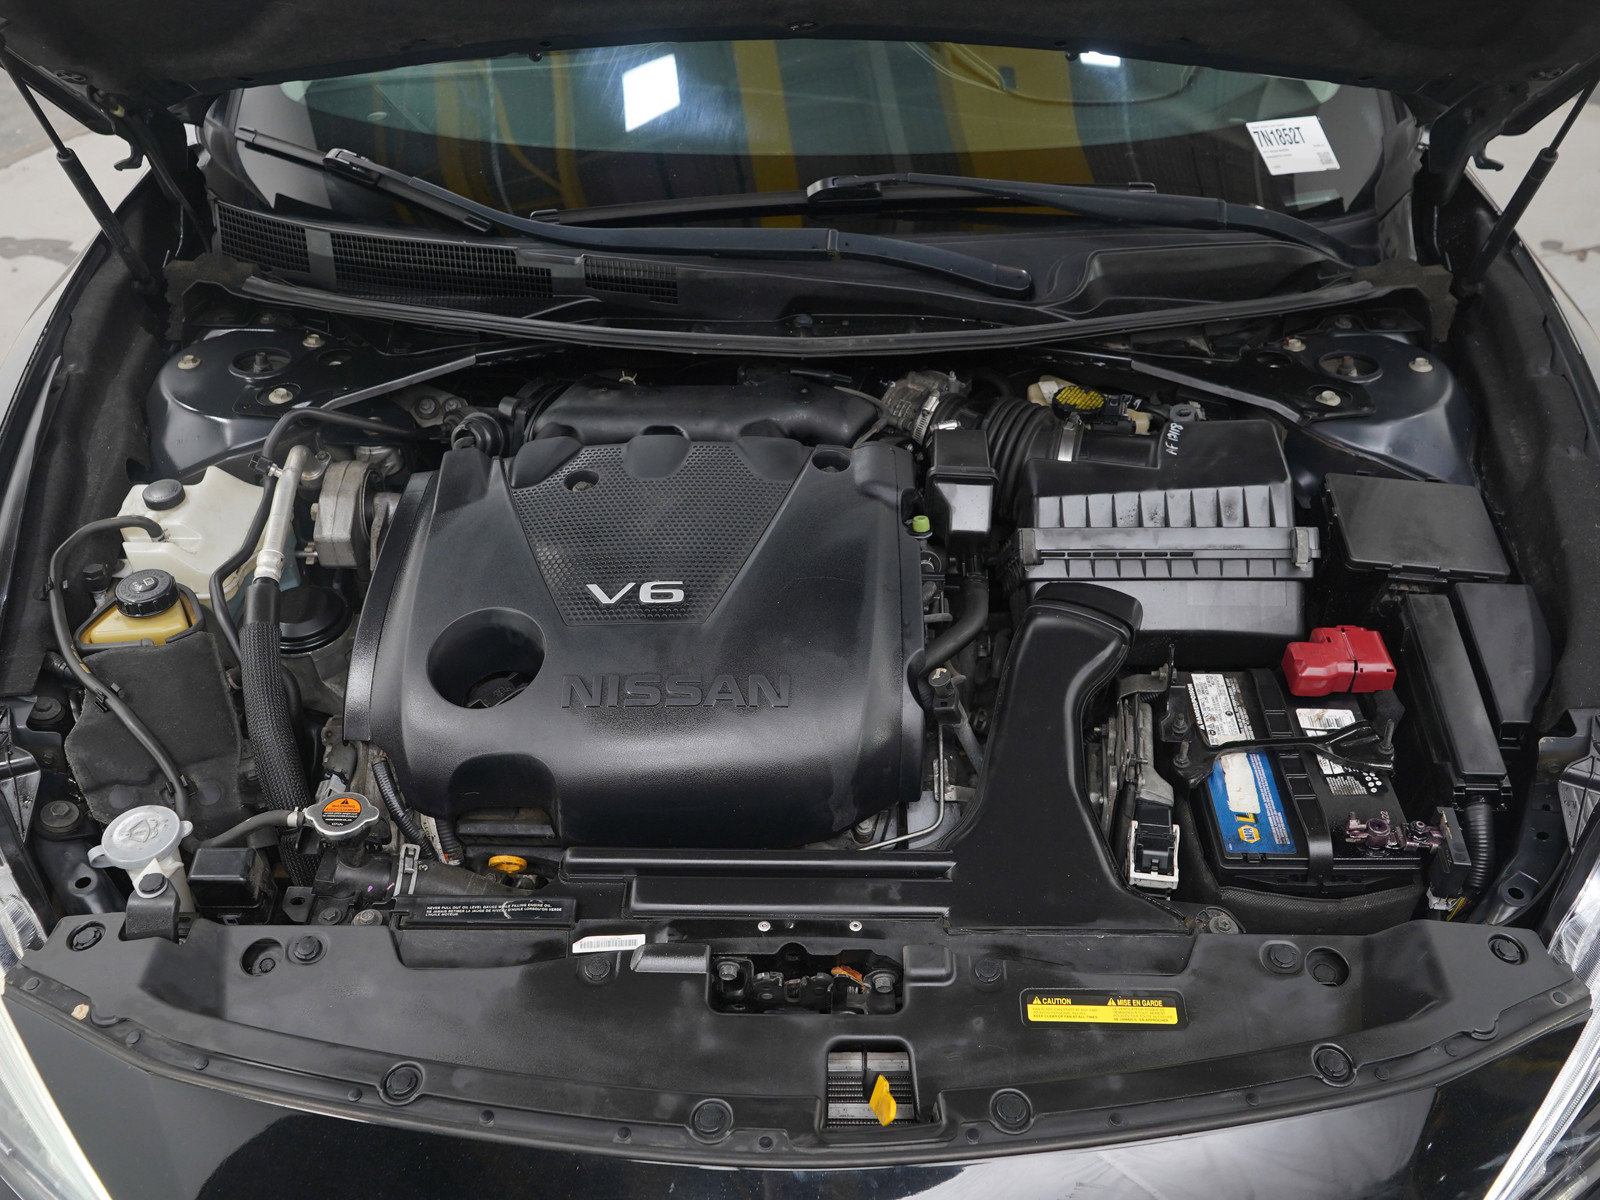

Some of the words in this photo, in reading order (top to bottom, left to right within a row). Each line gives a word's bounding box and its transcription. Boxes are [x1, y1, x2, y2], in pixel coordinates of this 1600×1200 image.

[1253, 126, 1306, 148] 7N1852T
[585, 580, 685, 604] V6
[560, 673, 791, 709] NISSAN
[1041, 997, 1072, 1005] CAUTION
[1116, 998, 1132, 1006] MISE
[1141, 999, 1163, 1007] GARDE
